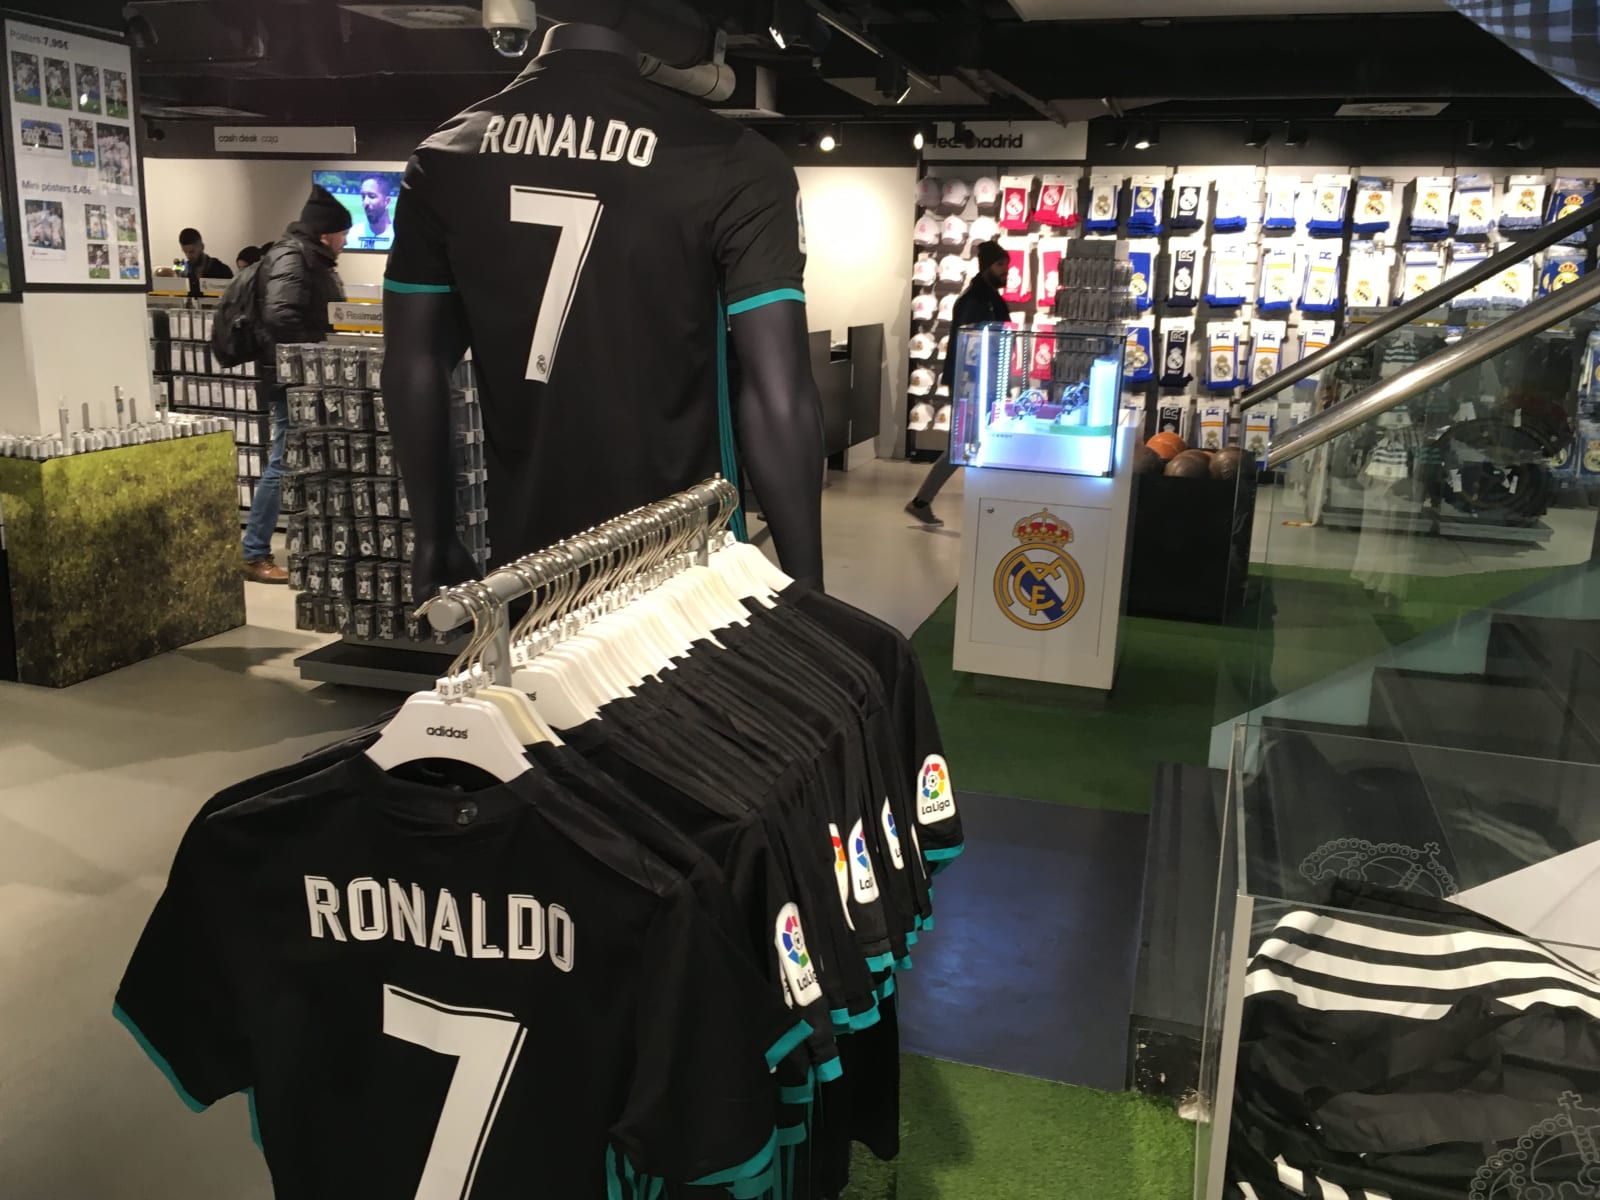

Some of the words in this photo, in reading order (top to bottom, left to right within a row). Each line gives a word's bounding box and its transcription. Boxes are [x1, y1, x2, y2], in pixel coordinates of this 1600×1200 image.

[479, 113, 658, 167] RONALDO
[510, 184, 604, 384] 7
[426, 725, 469, 740] adidas
[921, 799, 951, 815] LaLiga
[304, 874, 576, 973] RONALDO
[383, 983, 529, 1200] 7
